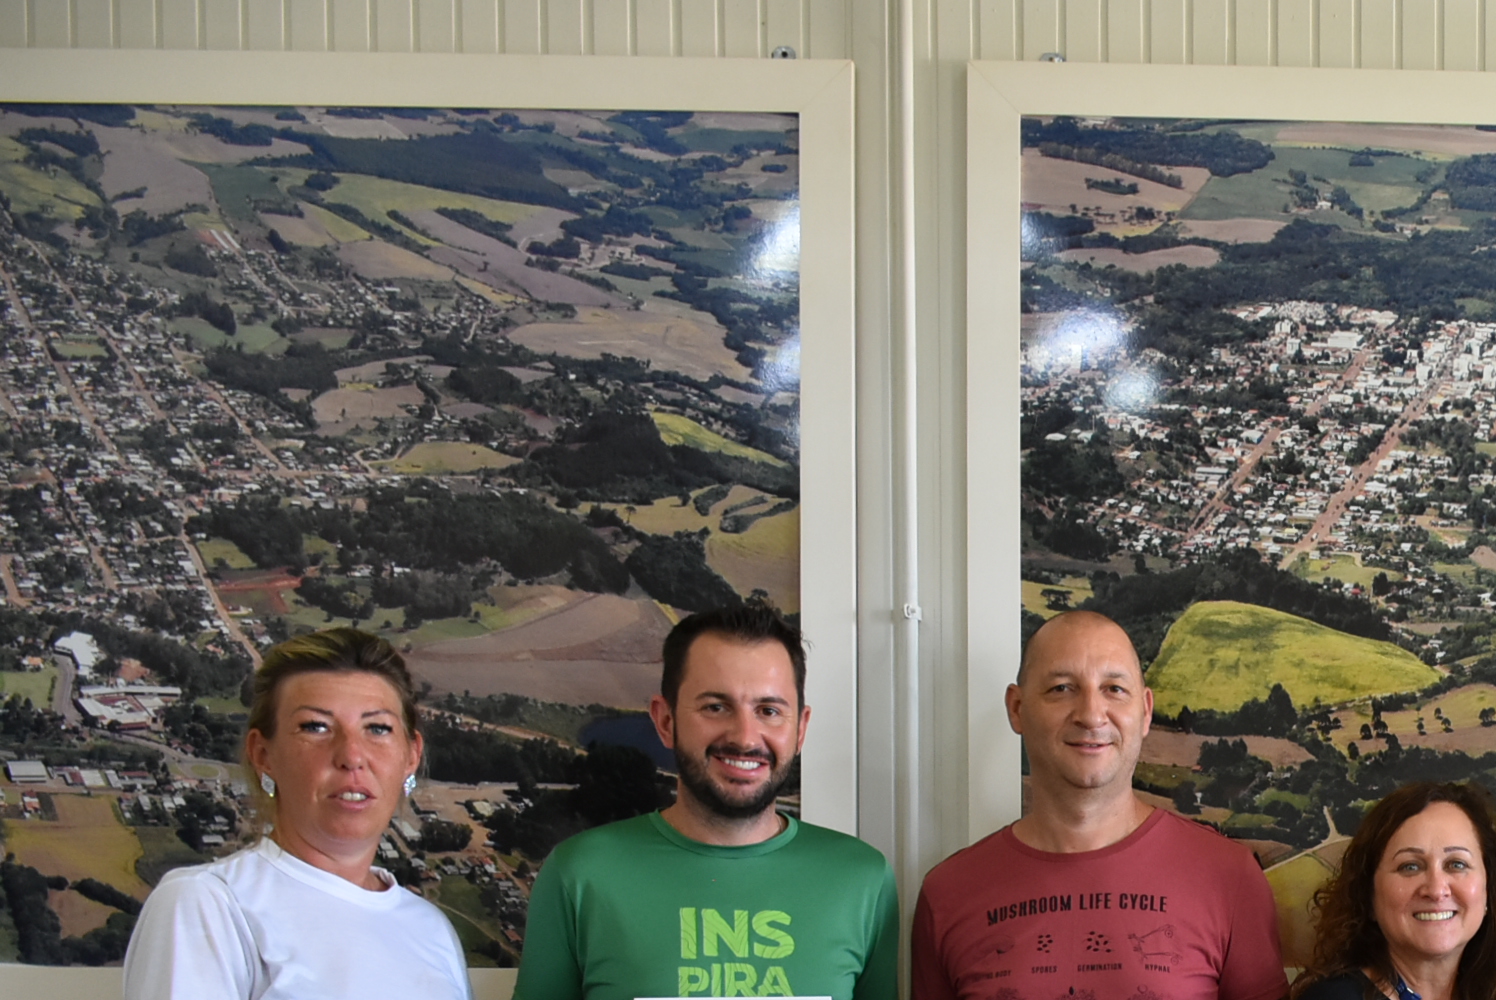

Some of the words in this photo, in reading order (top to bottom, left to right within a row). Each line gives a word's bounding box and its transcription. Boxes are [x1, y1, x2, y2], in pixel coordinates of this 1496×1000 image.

[986, 895, 1072, 926] MUSHROOM
[1079, 893, 1112, 910] LIFE
[1119, 893, 1167, 913] CYCLE
[679, 907, 795, 959] INS
[678, 962, 794, 997] PIRA
[1031, 965, 1057, 974] SPORES
[1077, 963, 1122, 972] GERMINATION
